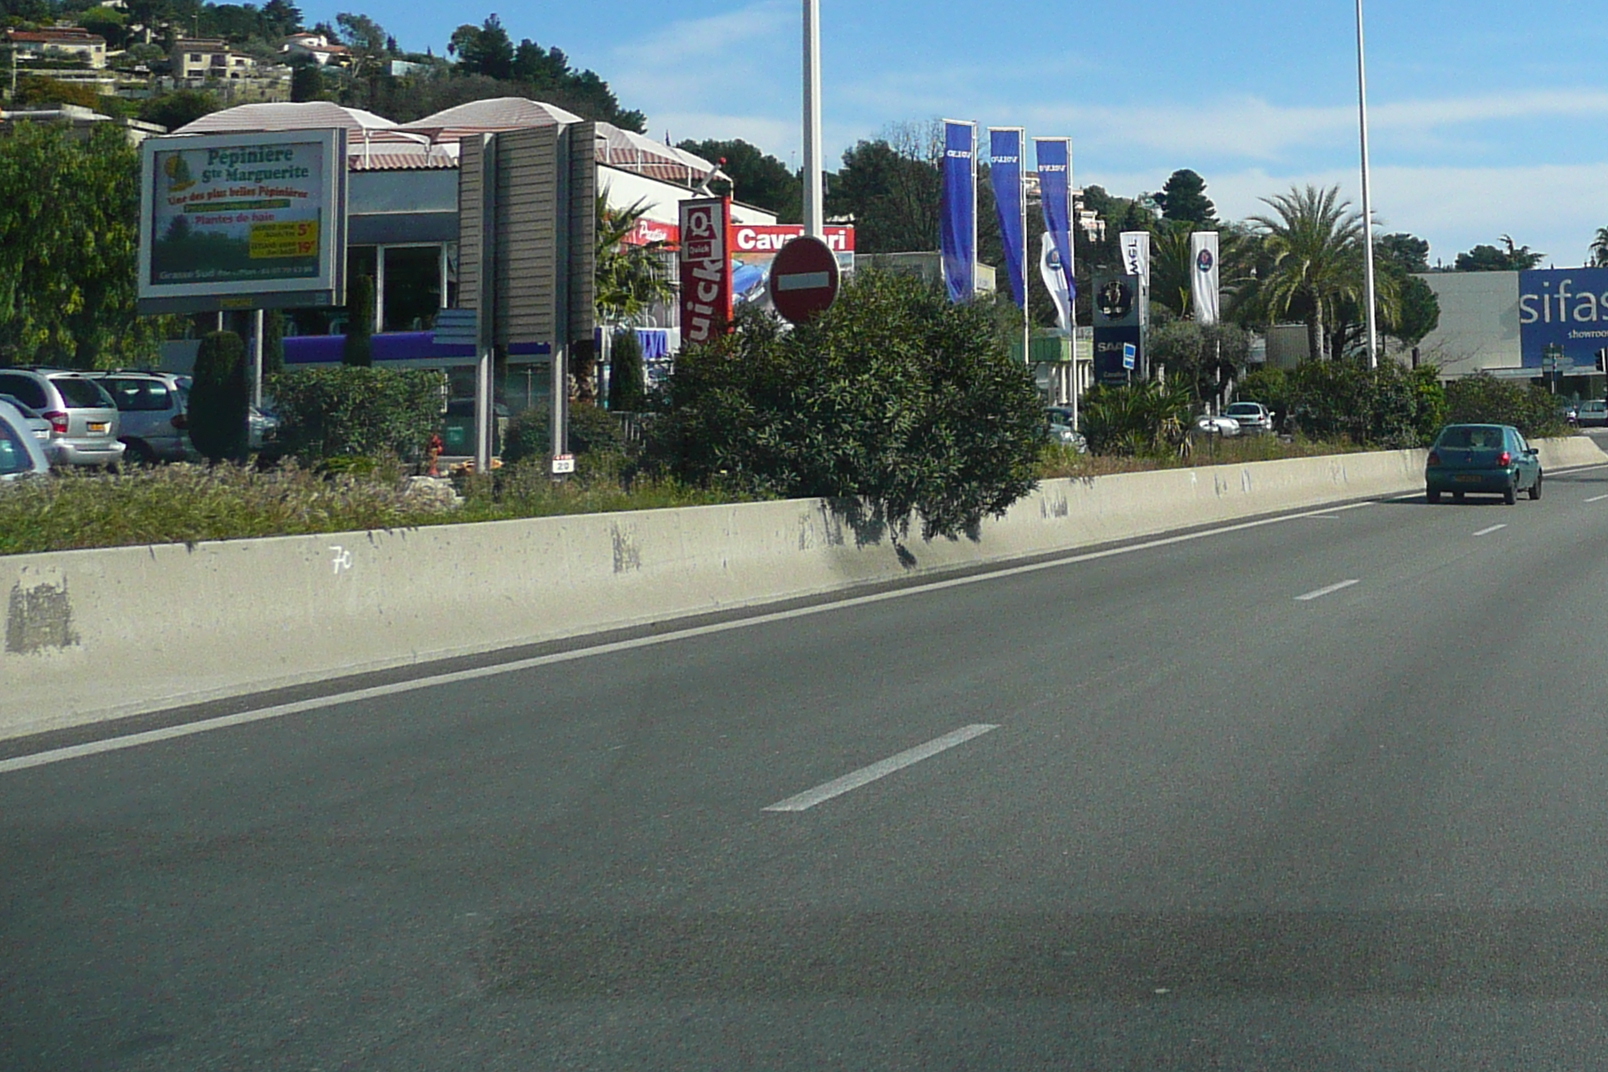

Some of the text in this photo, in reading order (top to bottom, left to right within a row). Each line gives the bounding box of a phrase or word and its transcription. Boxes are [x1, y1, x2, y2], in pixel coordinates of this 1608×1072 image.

[207, 145, 294, 168] Pépinière
[225, 165, 309, 184] Marguerite
[189, 192, 205, 202] des
[207, 188, 227, 201] plus
[229, 187, 256, 197] belles
[194, 214, 233, 225] Plantes
[236, 213, 250, 222] de
[689, 245, 710, 255] Quick
[686, 259, 724, 343] uick
